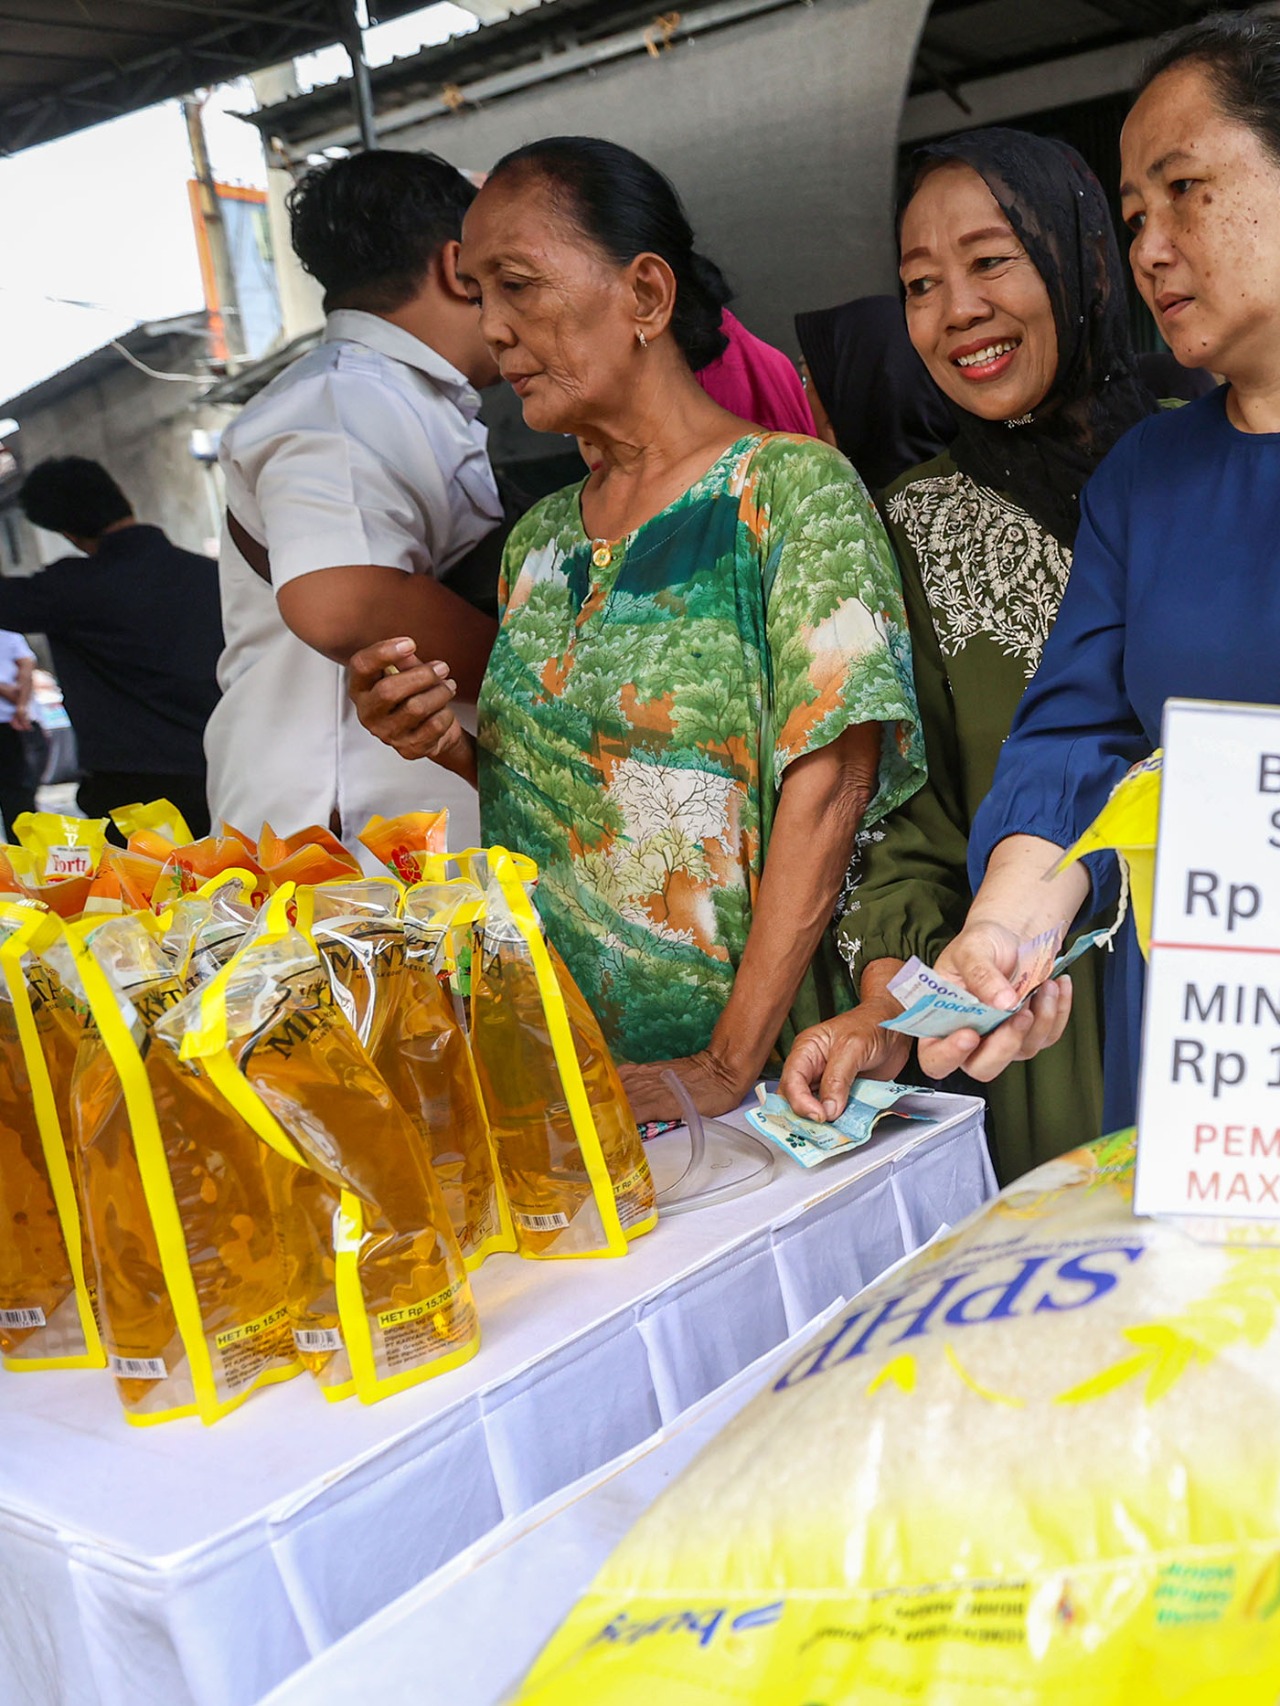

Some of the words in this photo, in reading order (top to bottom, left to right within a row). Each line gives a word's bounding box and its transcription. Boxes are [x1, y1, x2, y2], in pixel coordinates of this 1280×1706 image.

[1184, 870, 1261, 931] Rp
[1171, 1038, 1248, 1098] Rp
[1186, 1171, 1280, 1204] MAX
[218, 1330, 241, 1345] HET
[245, 1324, 260, 1336] Rp
[381, 1311, 404, 1325] HET
[408, 1306, 423, 1318] Rp
[773, 1247, 1145, 1392] SPHP
